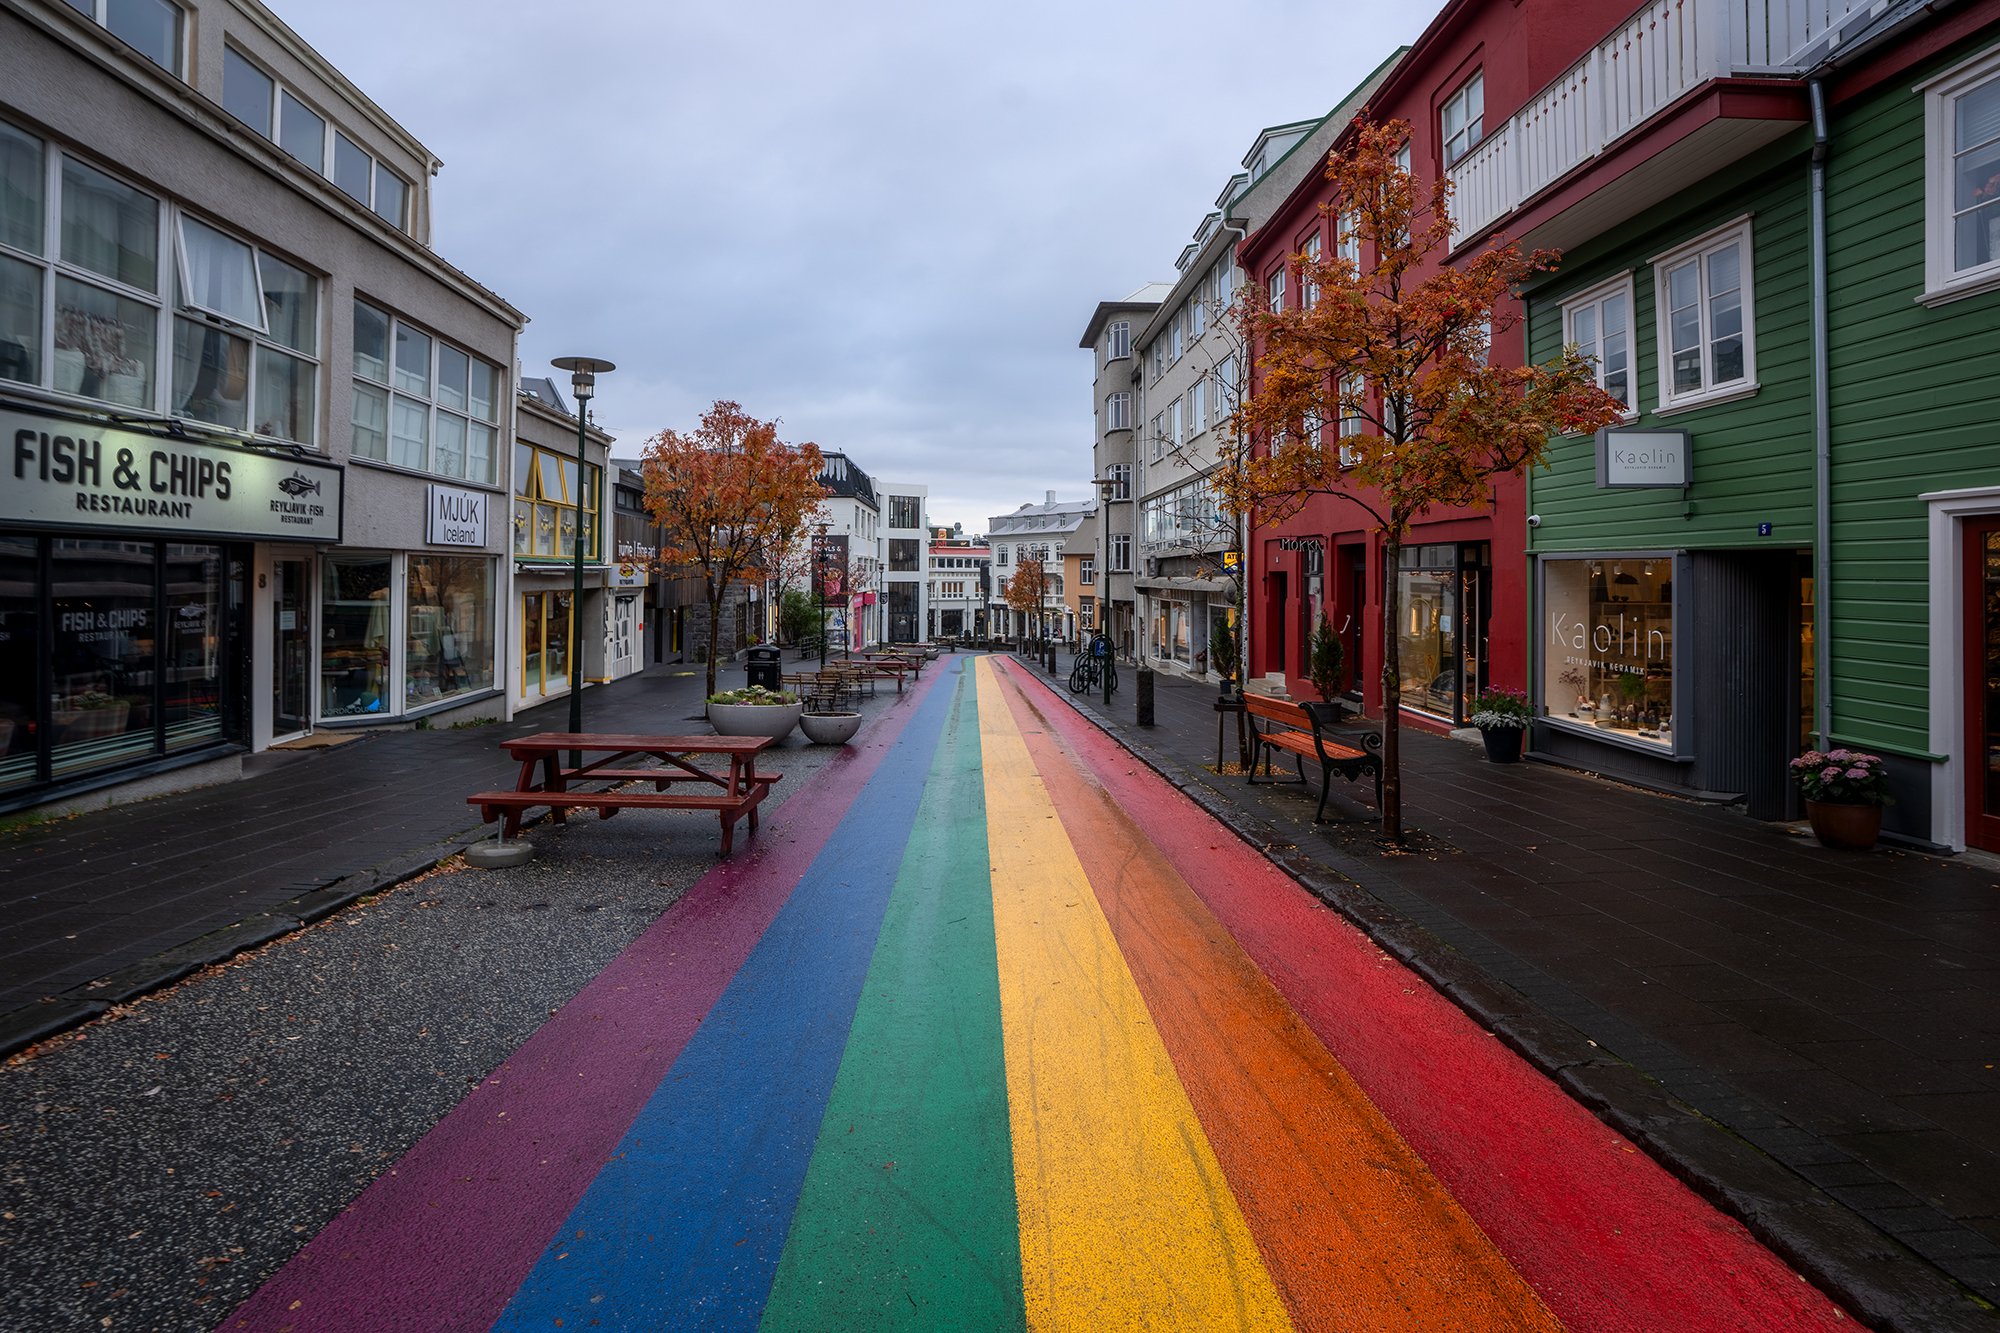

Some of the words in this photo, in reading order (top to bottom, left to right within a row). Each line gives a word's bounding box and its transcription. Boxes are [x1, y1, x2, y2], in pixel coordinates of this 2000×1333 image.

[14, 428, 101, 487] FISH
[113, 447, 141, 491] &
[149, 450, 232, 500] CHIPS
[1615, 448, 1675, 464] Kaolin
[76, 491, 193, 519] RESTAURANT
[270, 500, 307, 514] REYKJAVIK
[309, 504, 324, 517] FISH
[439, 492, 479, 525] MJÚK
[281, 514, 313, 525] RESTAURANT
[443, 523, 476, 544] Iceland
[1280, 538, 1323, 552] MOKKA
[62, 611, 95, 632] FISH
[97, 612, 108, 629] &
[108, 609, 147, 629] CHIPS
[78, 630, 130, 642] RESTAURANT
[1552, 611, 1664, 660] Kaolin
[1566, 655, 1606, 669] REYKJAVIK
[1609, 663, 1645, 676] KERAMIK
